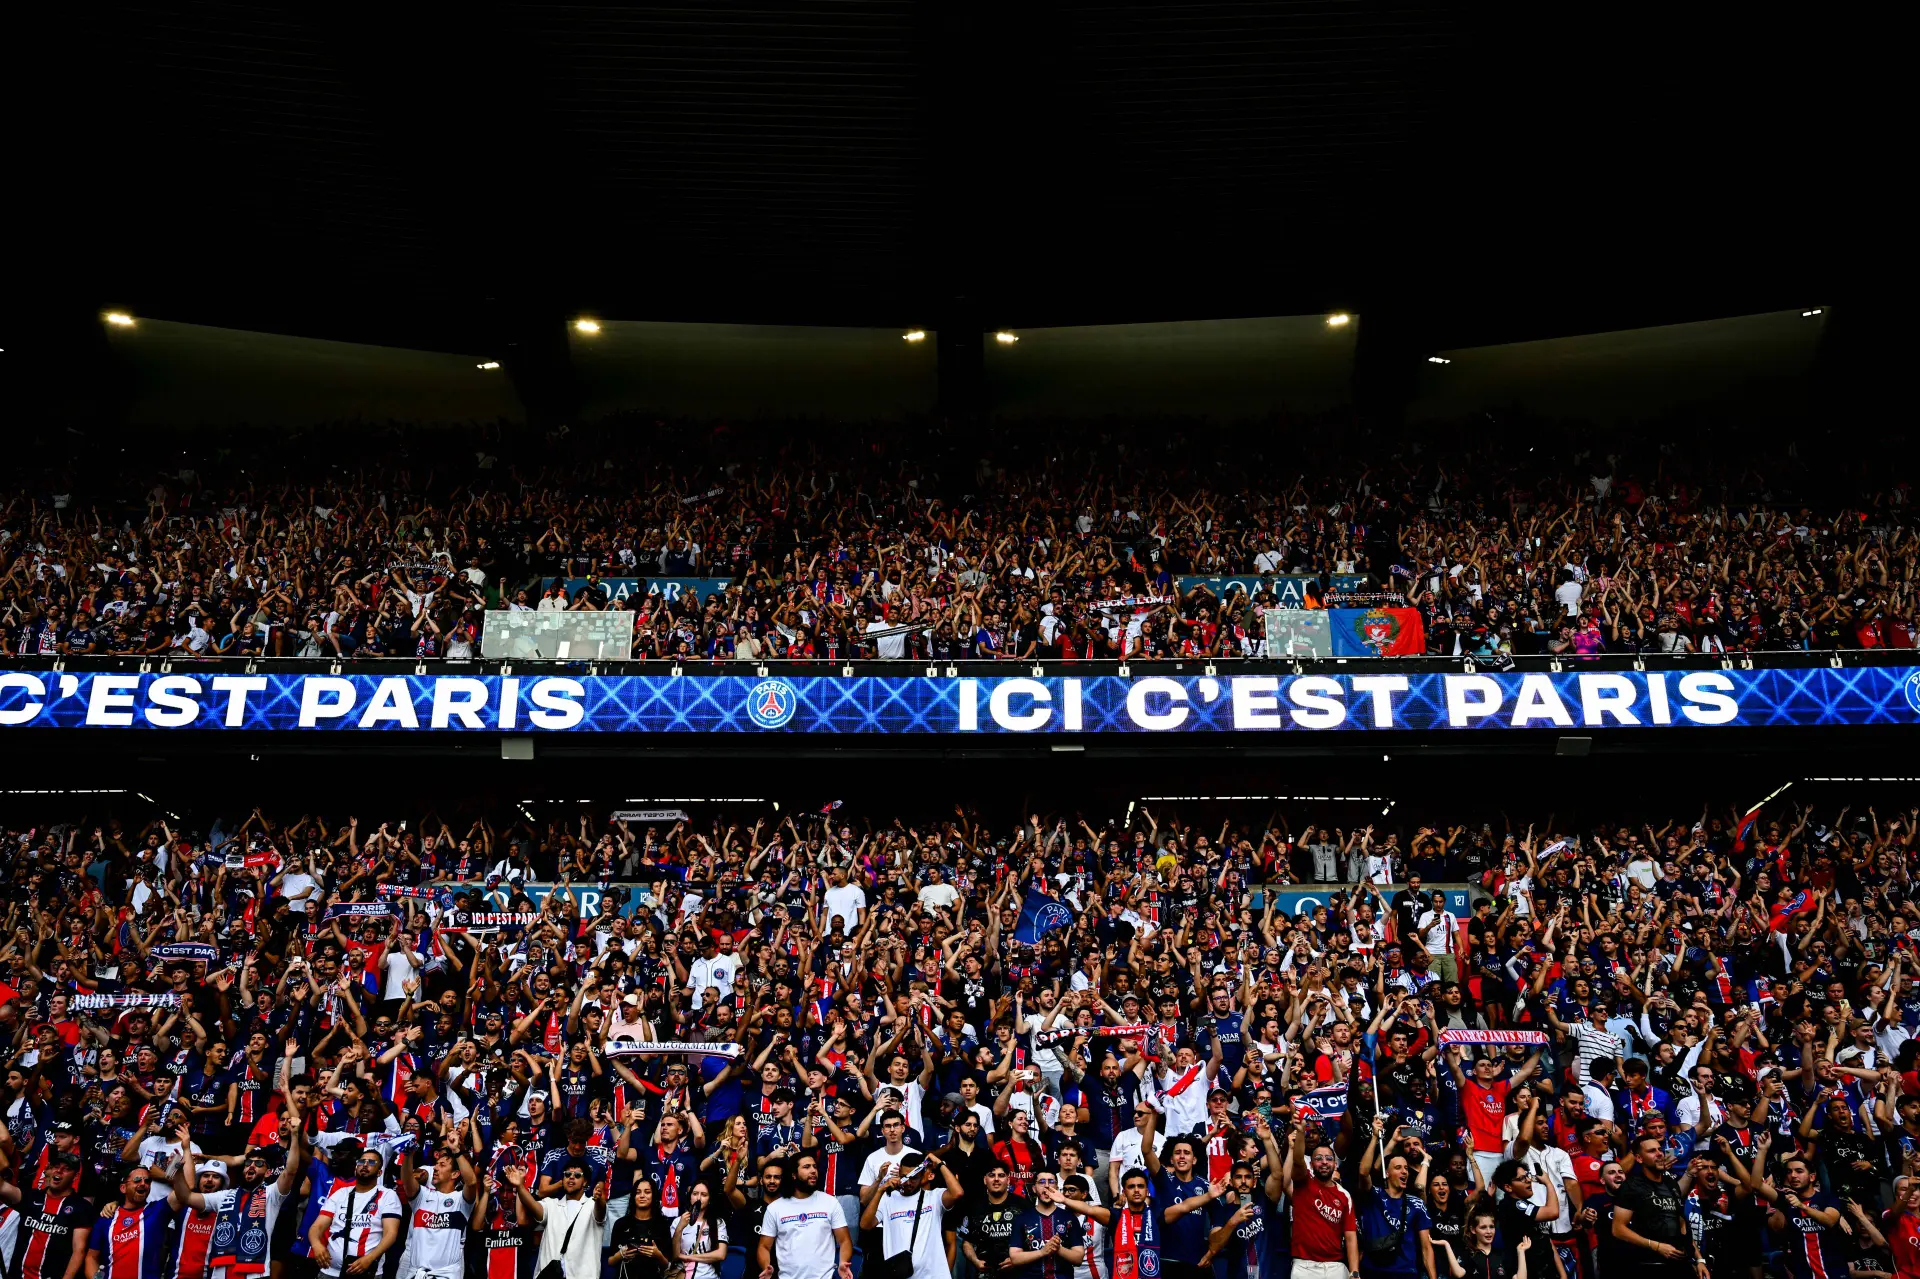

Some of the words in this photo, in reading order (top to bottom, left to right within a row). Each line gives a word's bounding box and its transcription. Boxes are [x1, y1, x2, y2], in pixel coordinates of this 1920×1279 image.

[756, 683, 788, 695] PARIS
[0, 674, 267, 727] C'EST
[299, 672, 585, 729] PARIS
[958, 675, 1082, 731] ICI
[1126, 674, 1410, 731] C'EST
[1446, 670, 1739, 727] PARIS
[1454, 895, 1465, 907] 127
[470, 912, 485, 924] ICI
[486, 912, 513, 925] C'EST
[1046, 904, 1070, 925] PARIS
[162, 946, 192, 955] C'EST
[627, 1040, 655, 1050] PARIS
[671, 1040, 718, 1051] GERMAIN
[562, 1084, 586, 1093] QATAR
[1405, 1116, 1433, 1132] QATAR
[1313, 1198, 1343, 1220] QATAR
[41, 1212, 56, 1224] Fly
[337, 1213, 371, 1223] QTAR
[421, 1212, 450, 1225] QATAR
[24, 1216, 69, 1236] Emirates
[186, 1222, 212, 1232] QATAR
[425, 1220, 450, 1230] AIRWAYS
[982, 1222, 1013, 1234] QATAR
[1237, 1217, 1264, 1240] QATAR
[1435, 1222, 1460, 1232] QATAR
[113, 1228, 139, 1242] QATAR
[498, 1230, 510, 1239] Fly
[484, 1236, 524, 1249] Emirates
